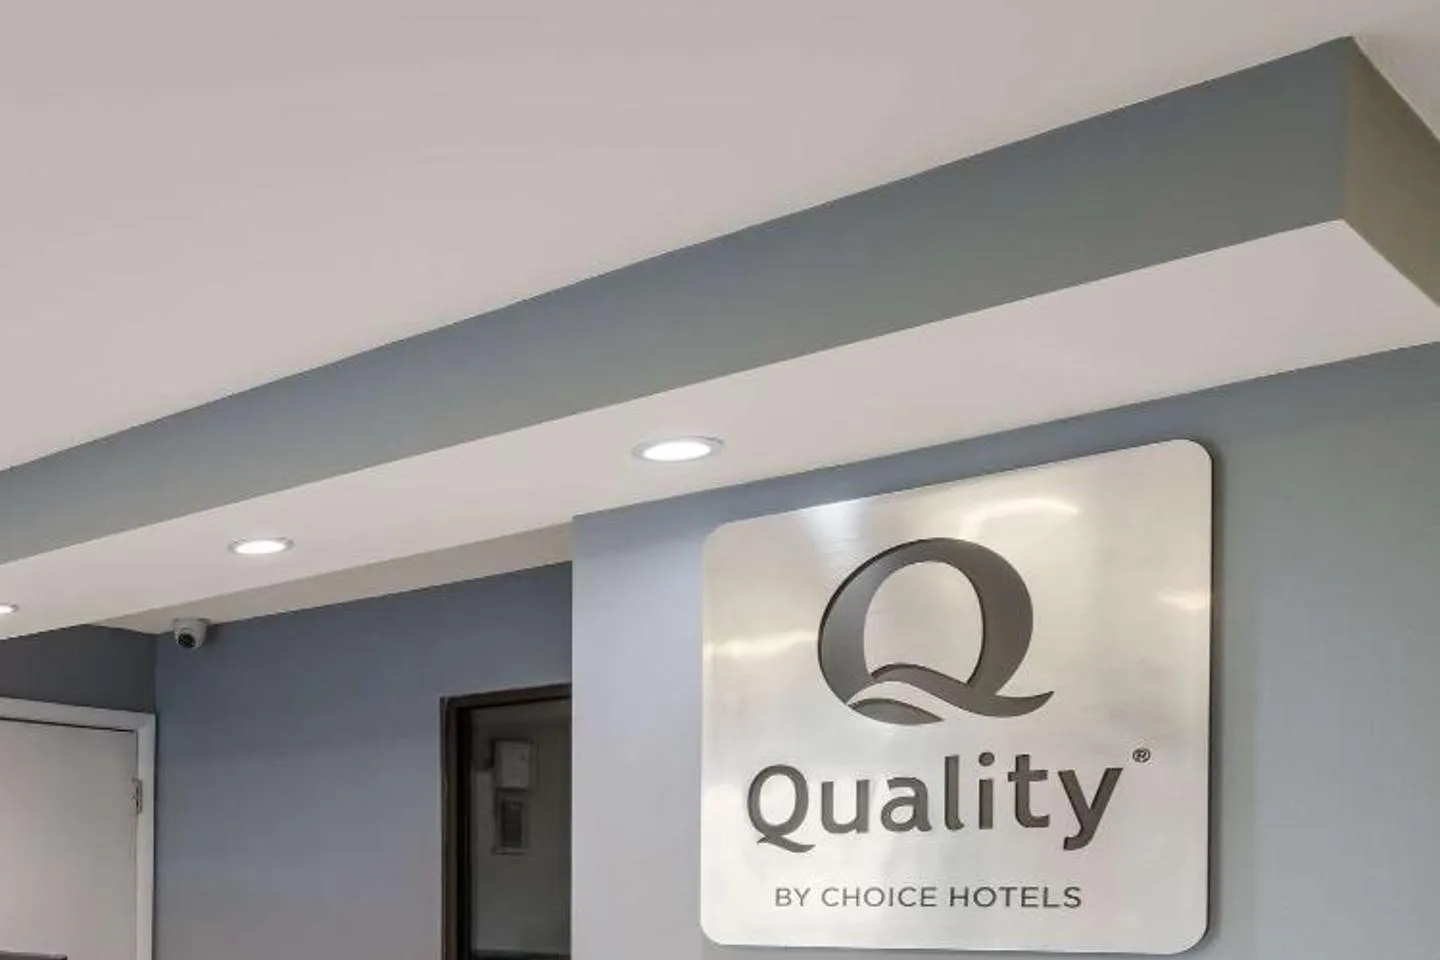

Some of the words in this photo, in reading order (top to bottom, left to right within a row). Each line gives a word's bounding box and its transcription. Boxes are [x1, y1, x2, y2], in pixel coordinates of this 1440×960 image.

[774, 886, 811, 908] BY
[820, 885, 937, 908] CHOICE
[948, 885, 1083, 910] HOTELS
